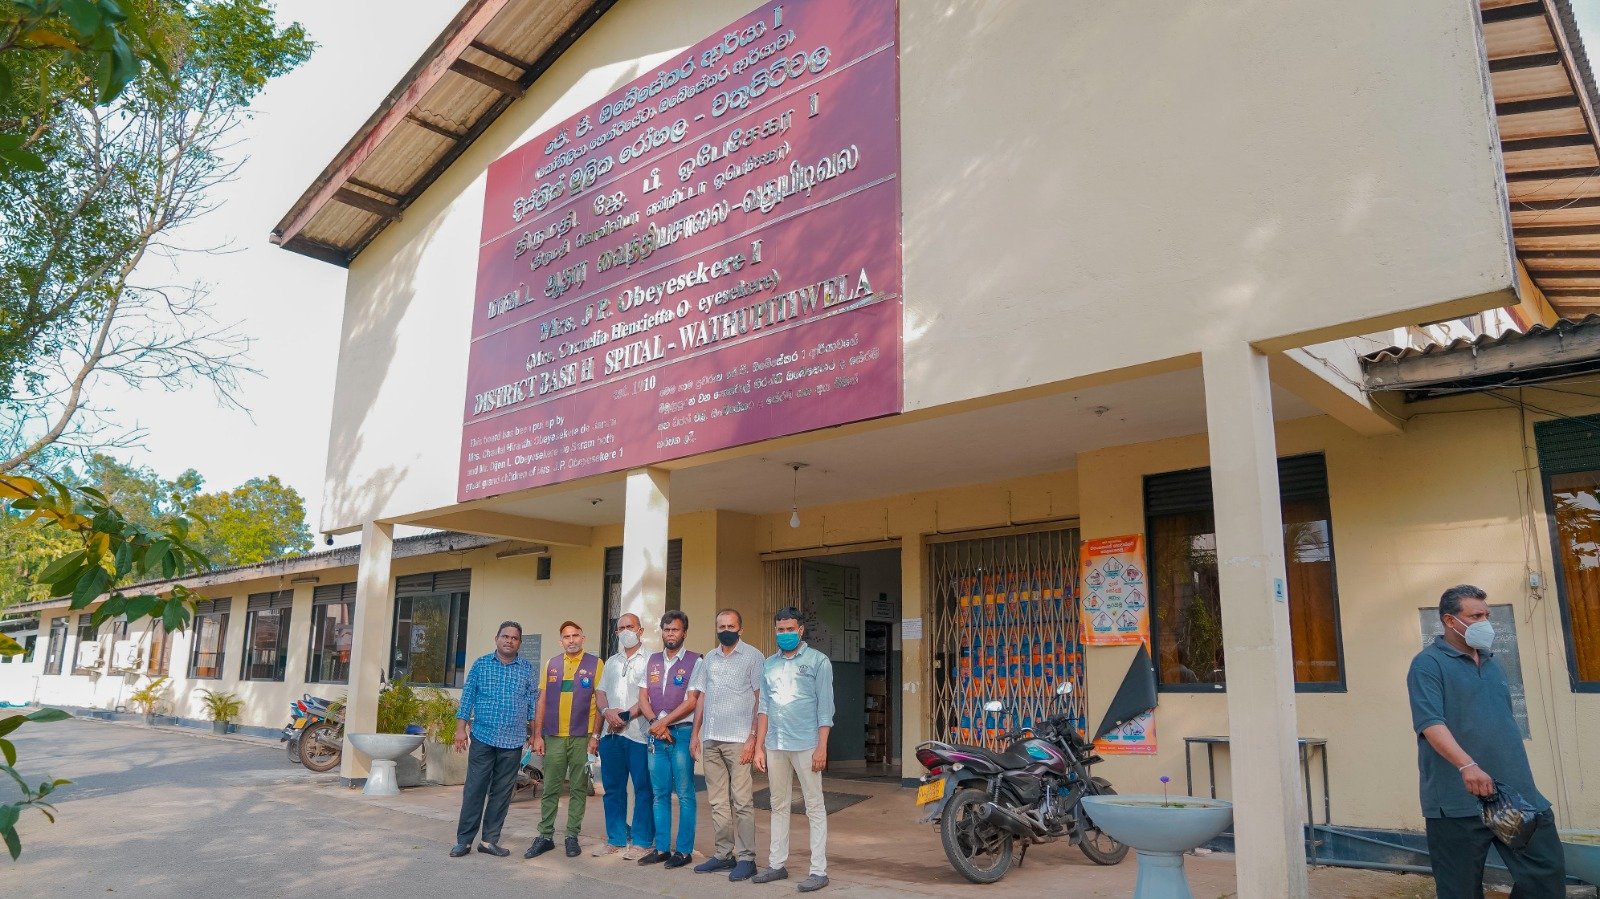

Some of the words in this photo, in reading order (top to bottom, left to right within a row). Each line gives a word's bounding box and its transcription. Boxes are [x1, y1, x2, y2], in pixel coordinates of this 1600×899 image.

[539, 317, 577, 342] Mrs.
[617, 253, 745, 313] Obeyesekere
[610, 309, 675, 343] Henrietta
[474, 375, 537, 416] DISTRICT
[539, 362, 578, 396] BASE
[556, 416, 565, 426] by
